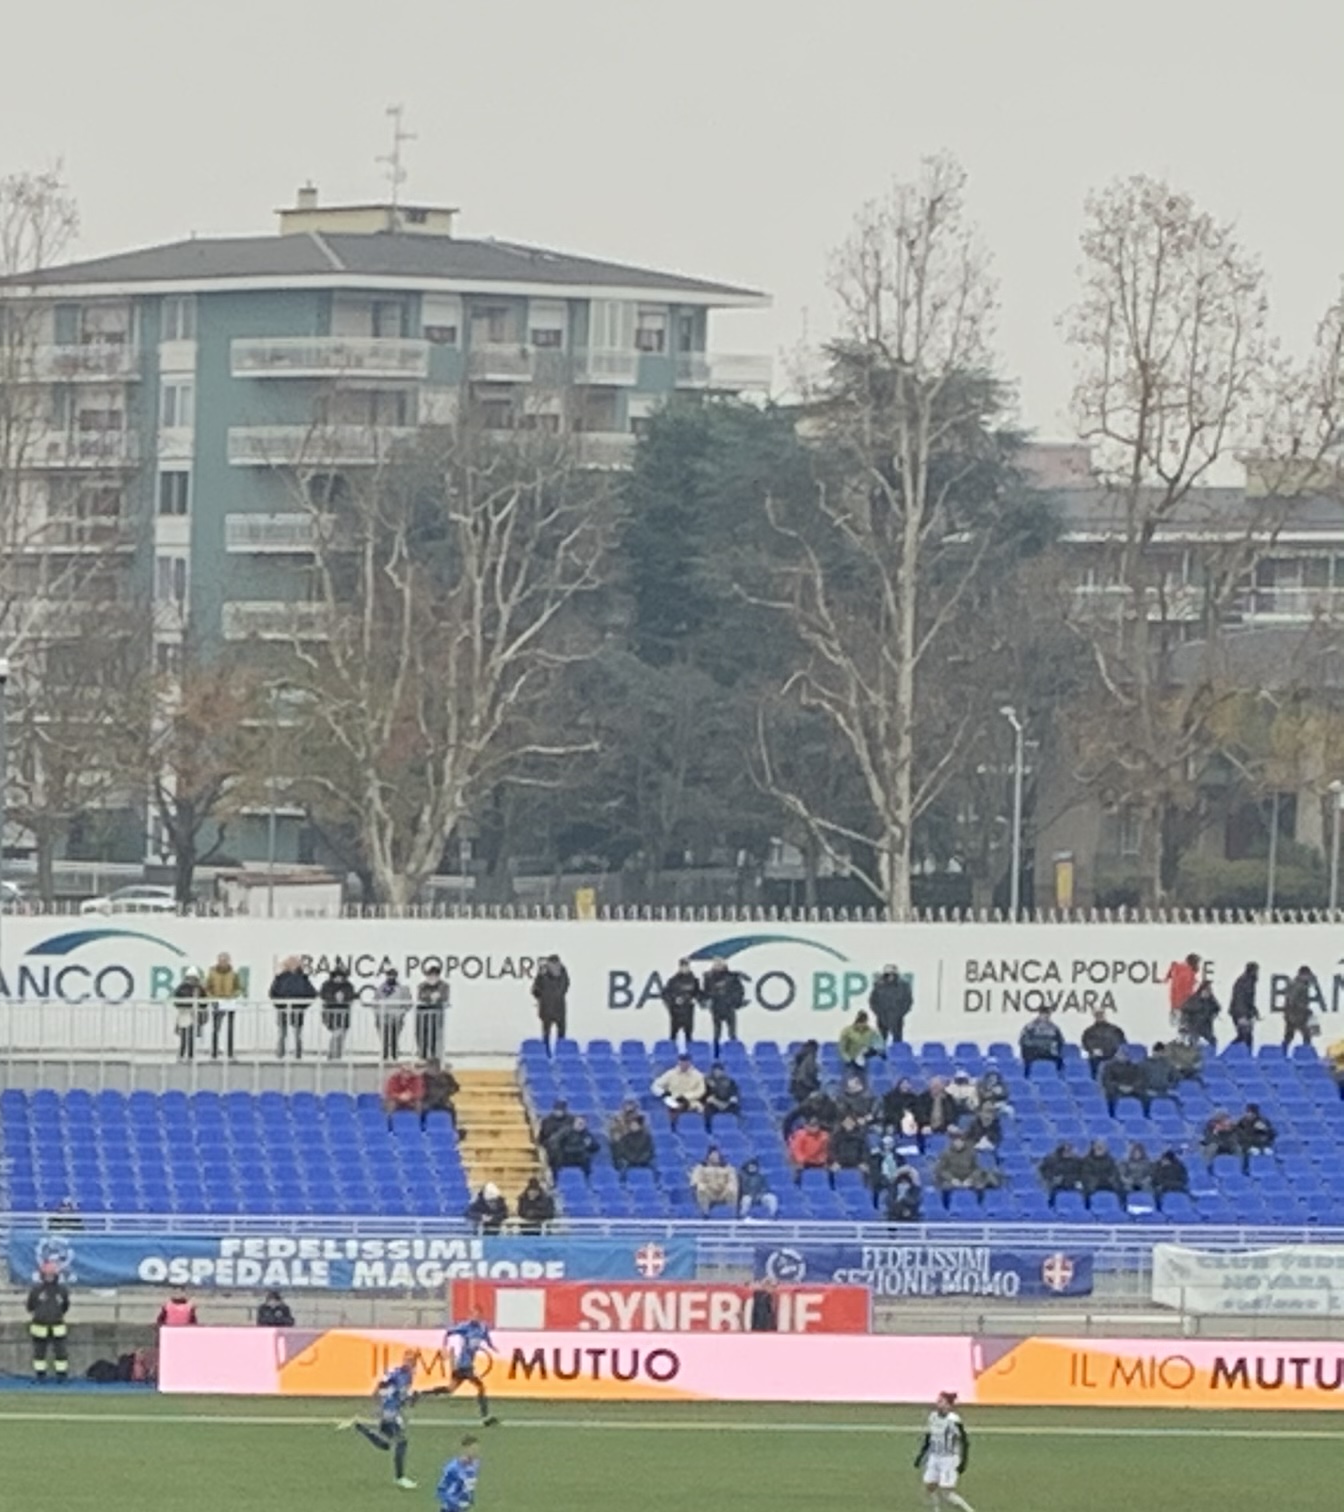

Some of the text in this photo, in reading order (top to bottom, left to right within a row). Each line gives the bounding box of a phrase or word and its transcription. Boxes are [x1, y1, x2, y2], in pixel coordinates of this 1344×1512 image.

[966, 959, 1215, 984] BANCA POPOLE
[812, 971, 914, 1011] BP
[963, 989, 1118, 1013] DI NOVARA
[220, 1238, 484, 1260] FEDELISSIMI
[863, 1246, 990, 1271] FEDELISSIMI
[138, 1258, 329, 1285] OSPEDALE
[941, 1269, 1020, 1297] MOMO
[507, 1348, 680, 1381] MUTUO
[1070, 1353, 1096, 1387] IL
[1110, 1355, 1195, 1389] MIO
